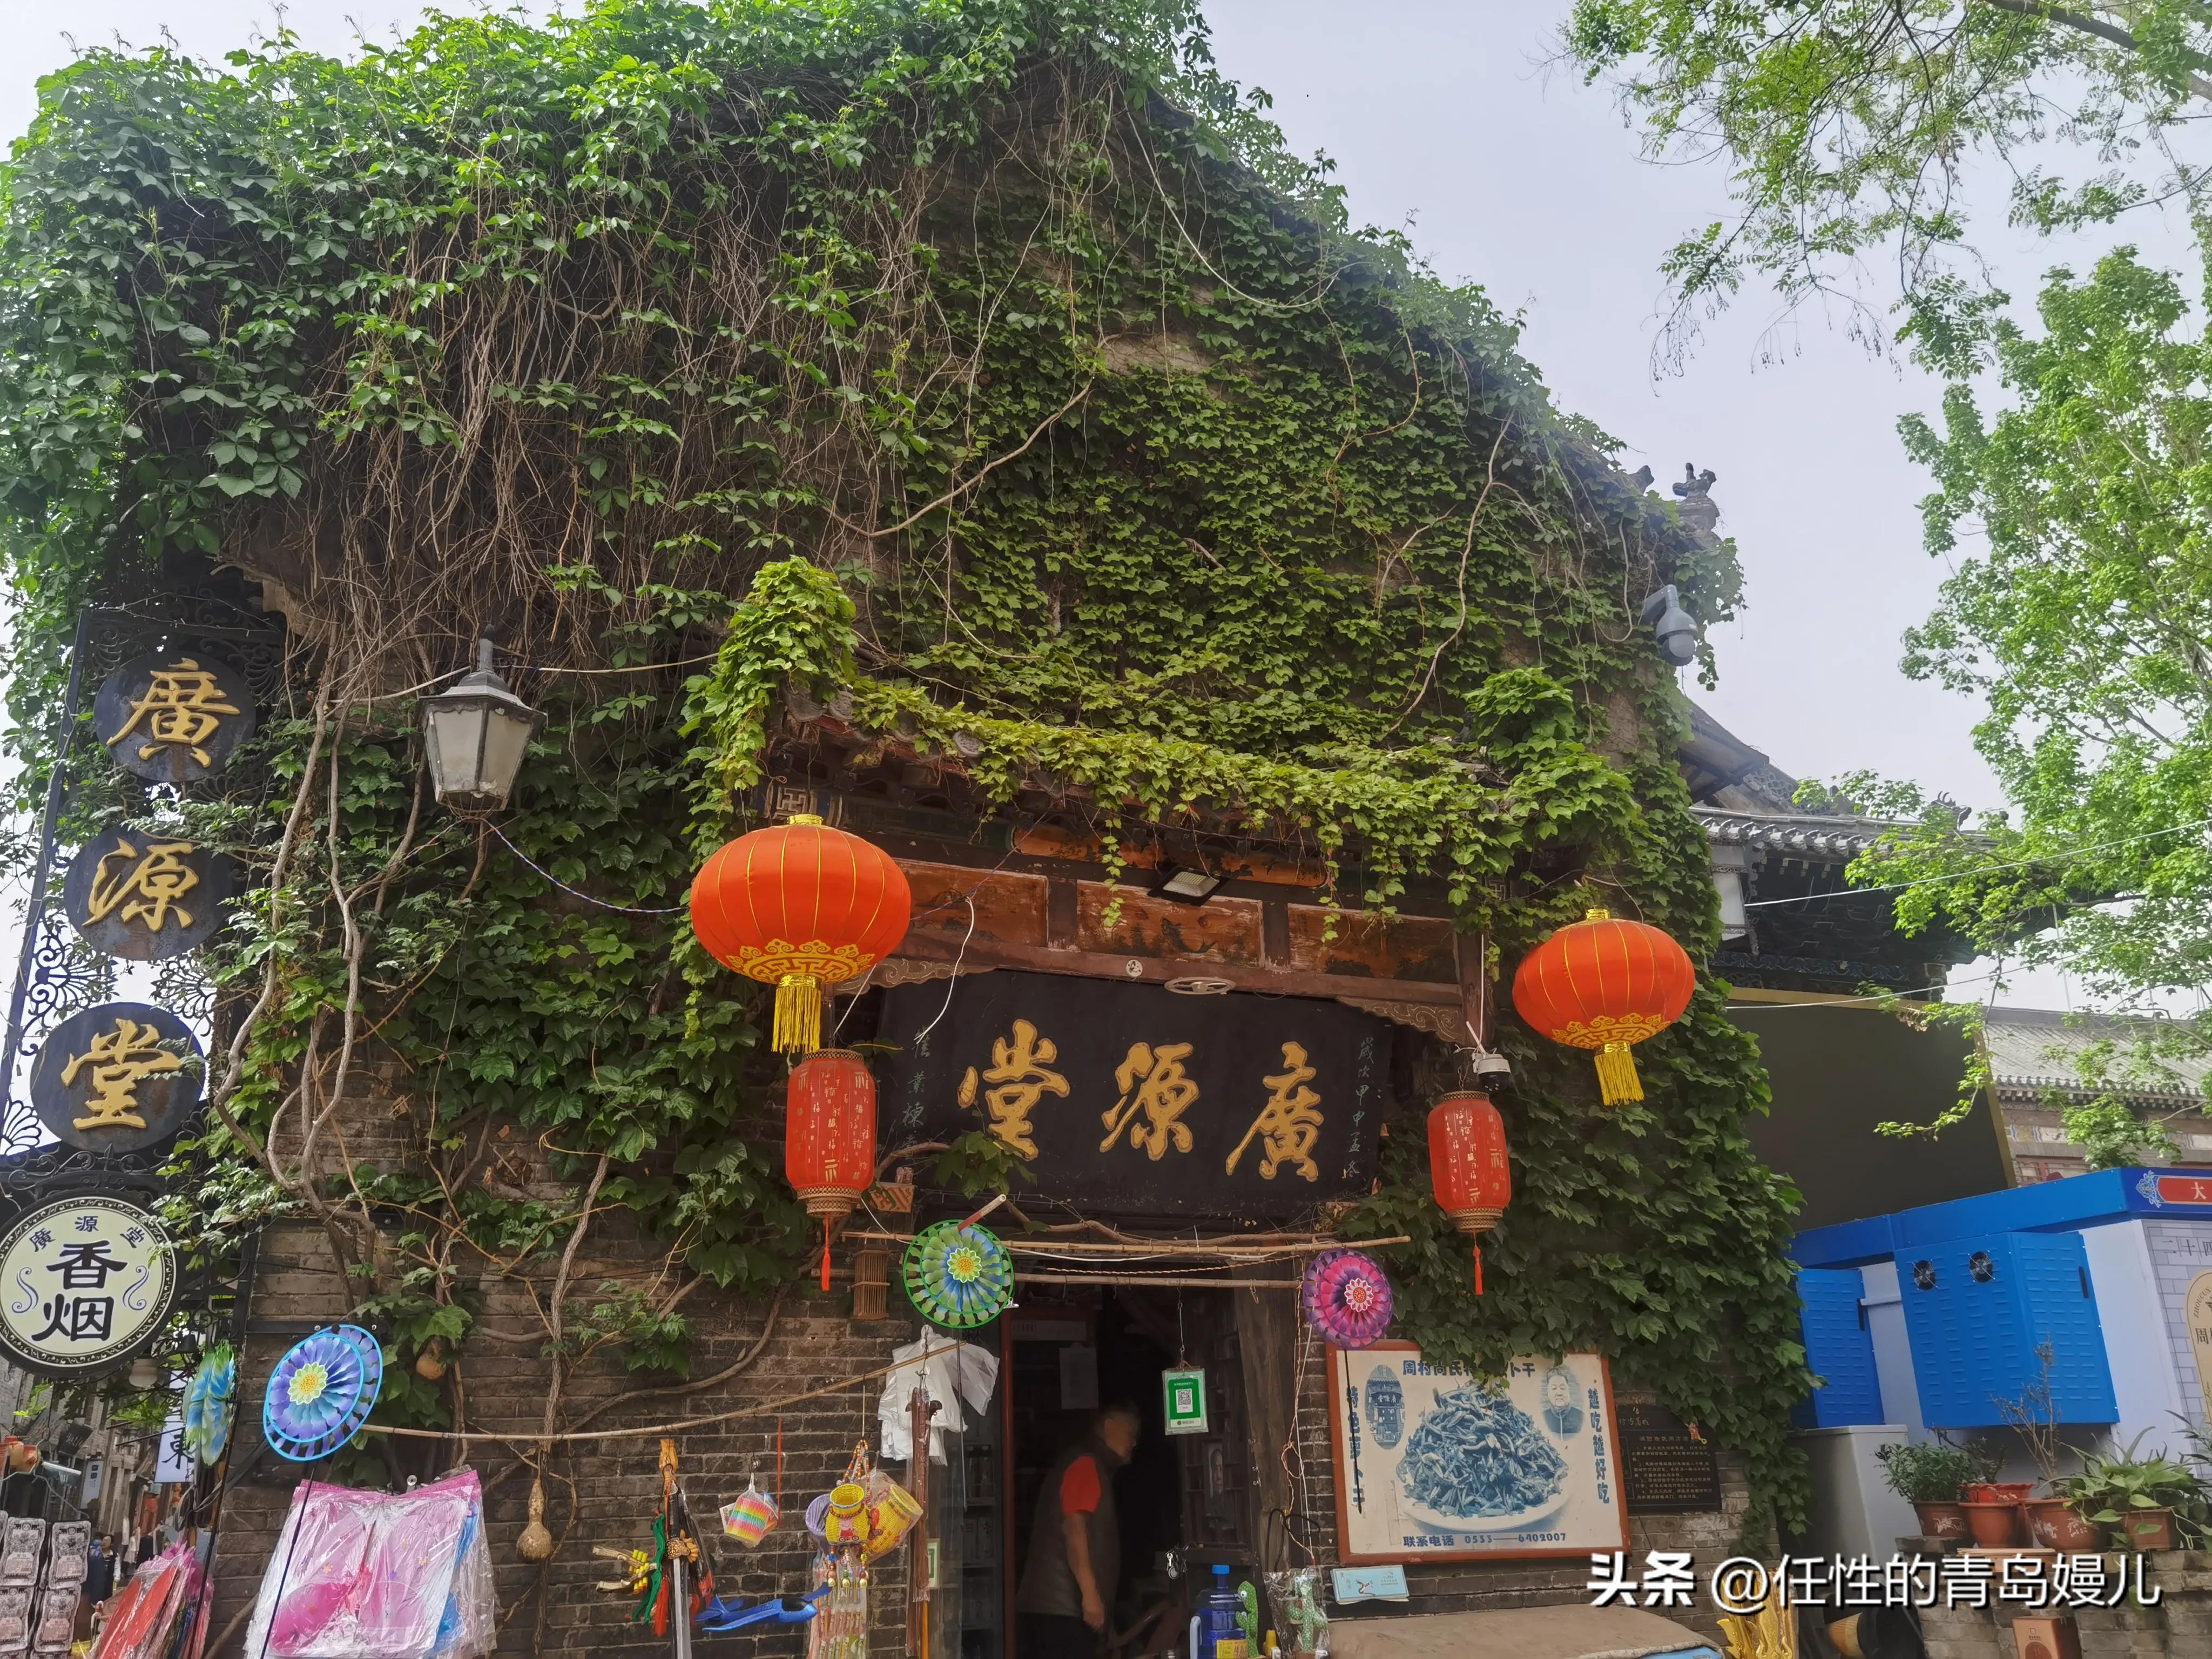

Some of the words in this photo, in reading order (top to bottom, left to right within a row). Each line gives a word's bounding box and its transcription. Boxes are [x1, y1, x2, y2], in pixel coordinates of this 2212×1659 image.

[2190, 1182, 2207, 1200] 大
[29, 1216, 145, 1252] 廣源堂
[31, 1240, 128, 1342] 香烟
[2195, 1327, 2212, 1345] 周
[1588, 1388, 1610, 1504] 越吃越好吃
[1403, 1535, 1454, 1547] 联系电话
